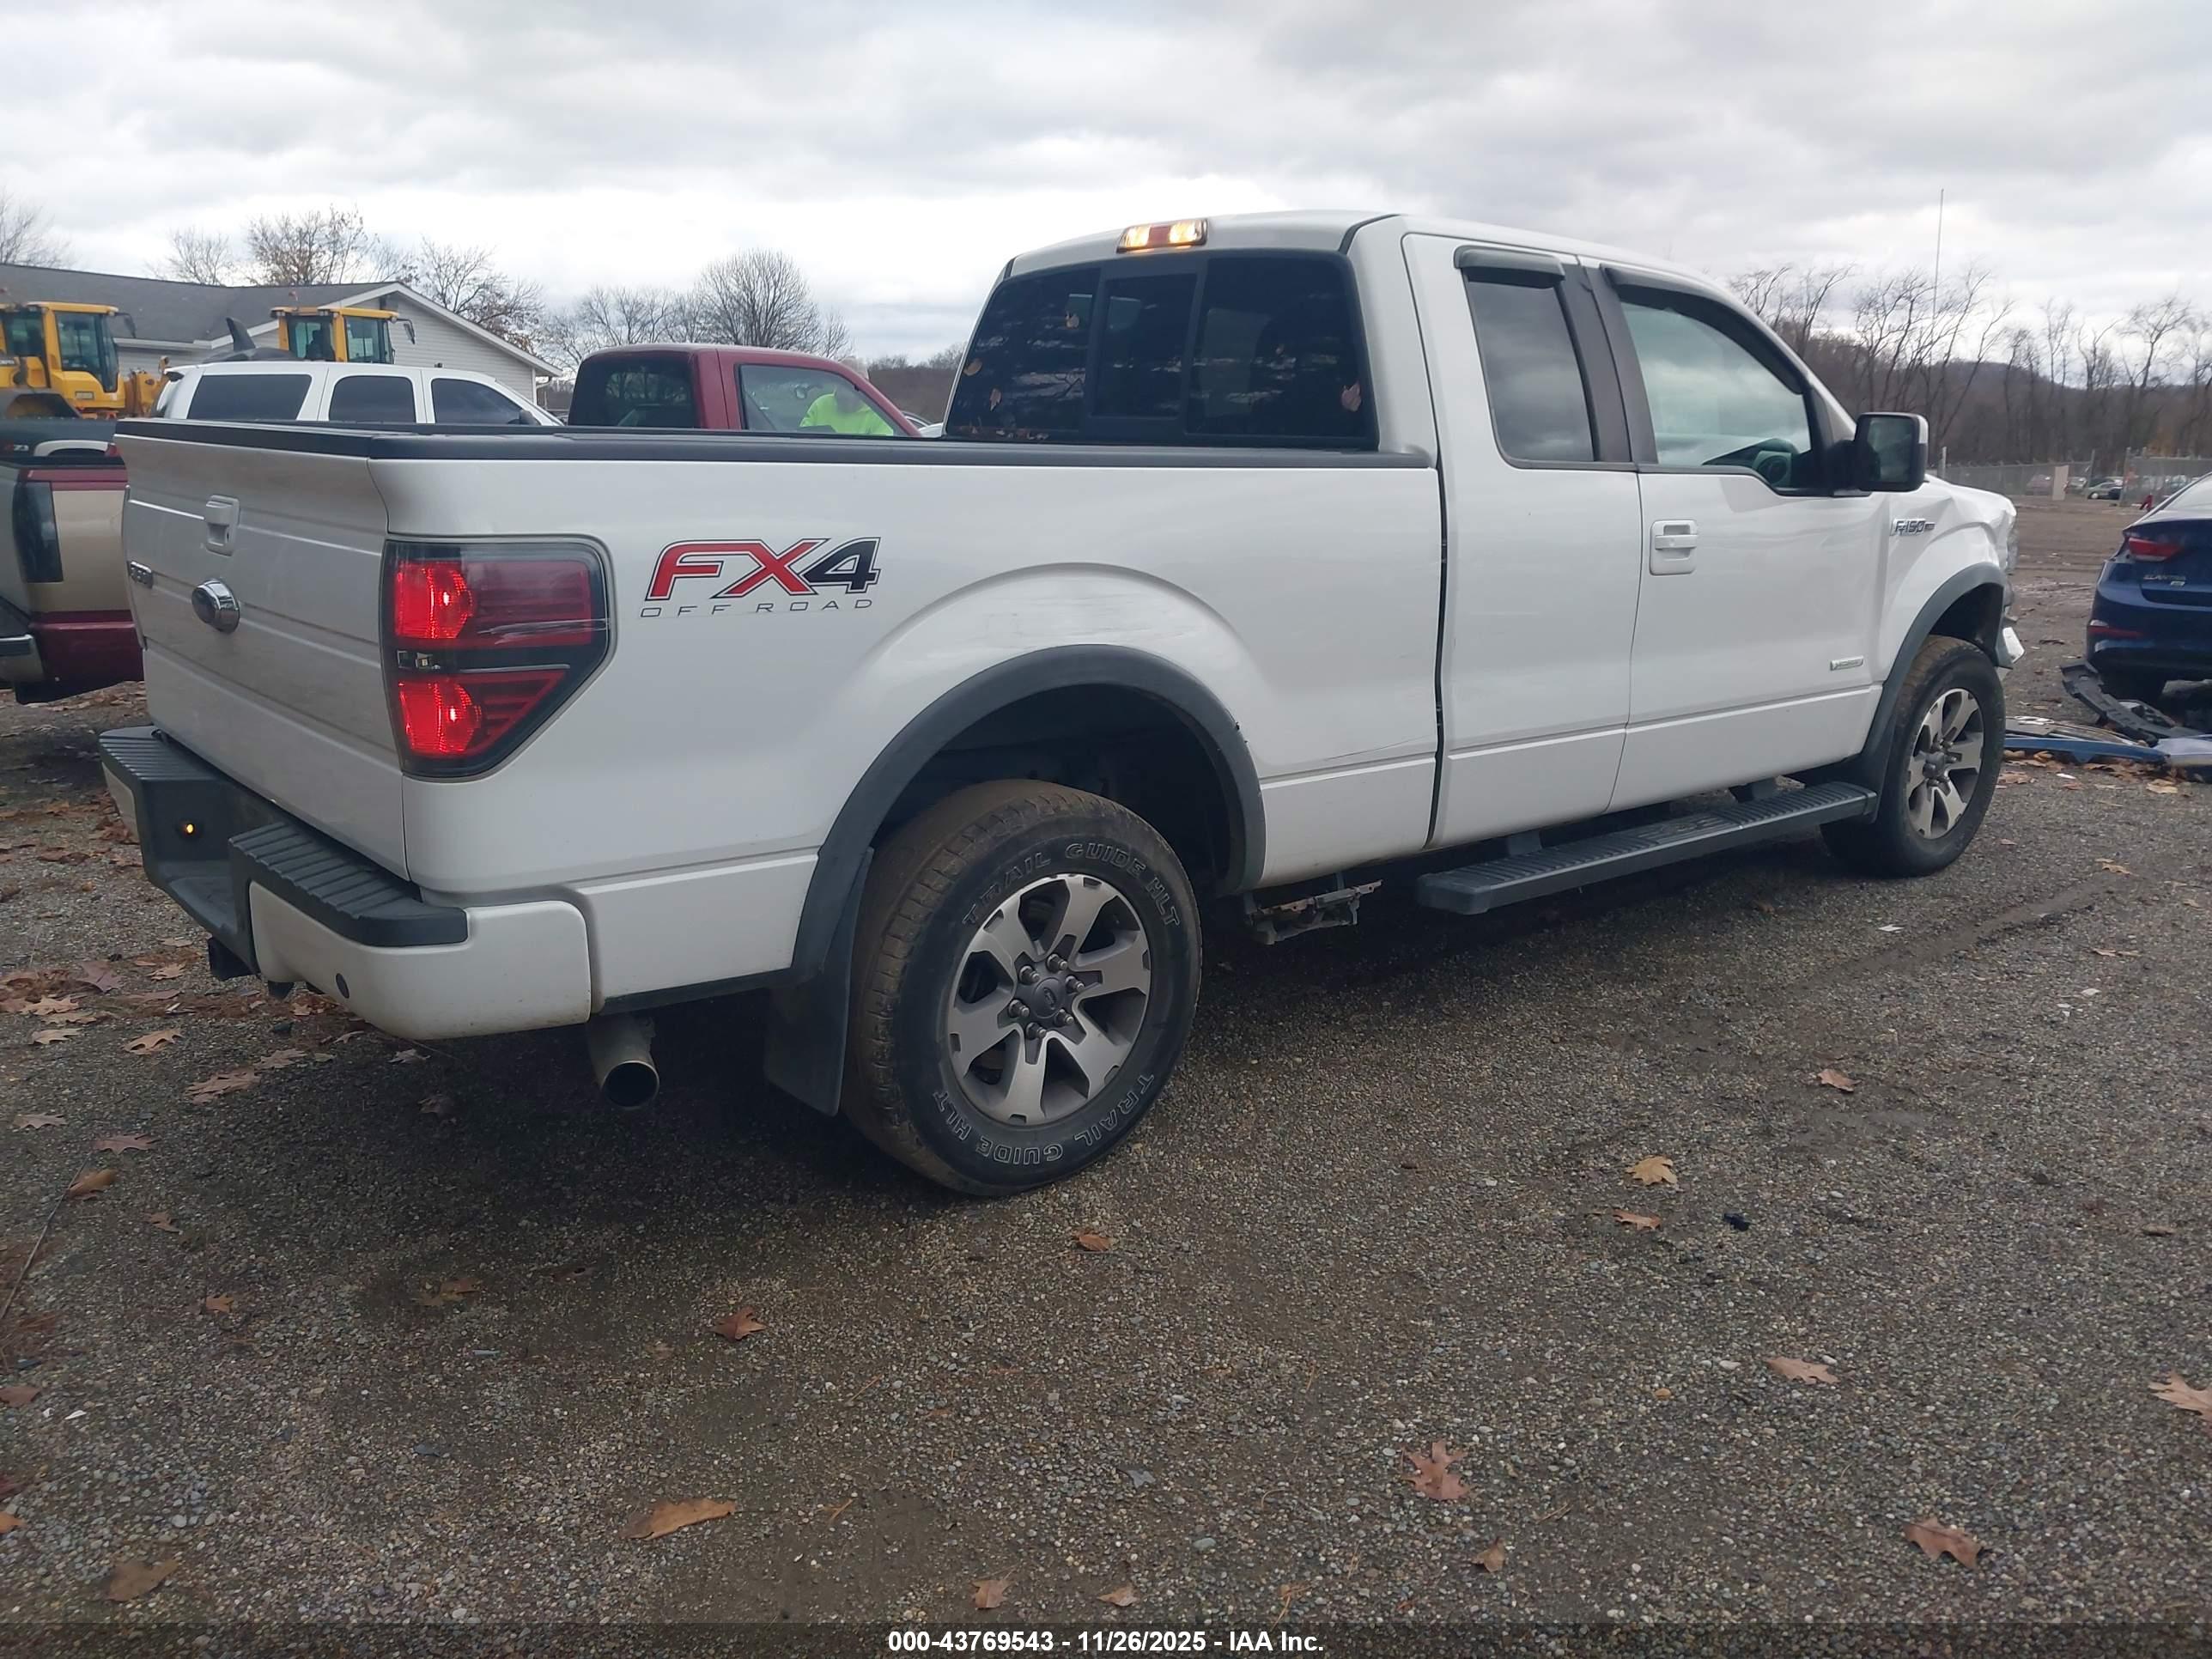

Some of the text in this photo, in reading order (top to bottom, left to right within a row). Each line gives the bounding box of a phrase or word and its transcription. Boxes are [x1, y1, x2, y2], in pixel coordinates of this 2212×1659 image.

[645, 537, 881, 601] FX4
[640, 599, 873, 617] OFF ROAD
[961, 842, 1182, 927] TRAIL GUIDE HLT
[933, 1073, 1154, 1165] TRAIL GUIDE HLT
